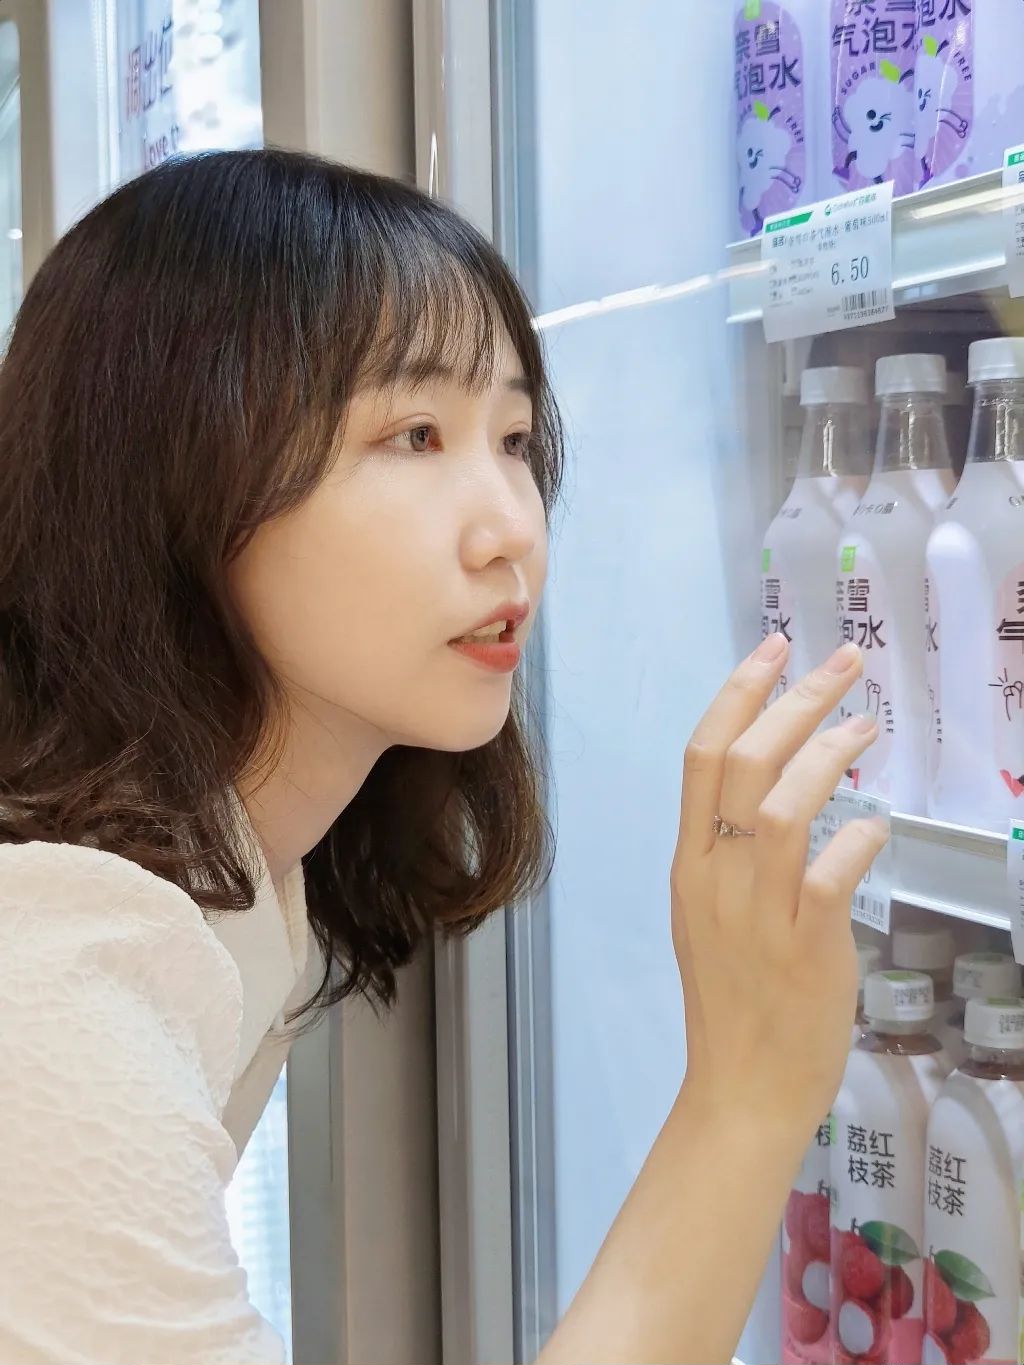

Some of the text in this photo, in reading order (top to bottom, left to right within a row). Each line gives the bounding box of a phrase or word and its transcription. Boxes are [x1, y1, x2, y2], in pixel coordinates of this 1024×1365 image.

[841, 62, 876, 95] SUGAR
[953, 51, 972, 81] FREE
[831, 256, 869, 286] 6.50
[882, 700, 894, 734] FREE
